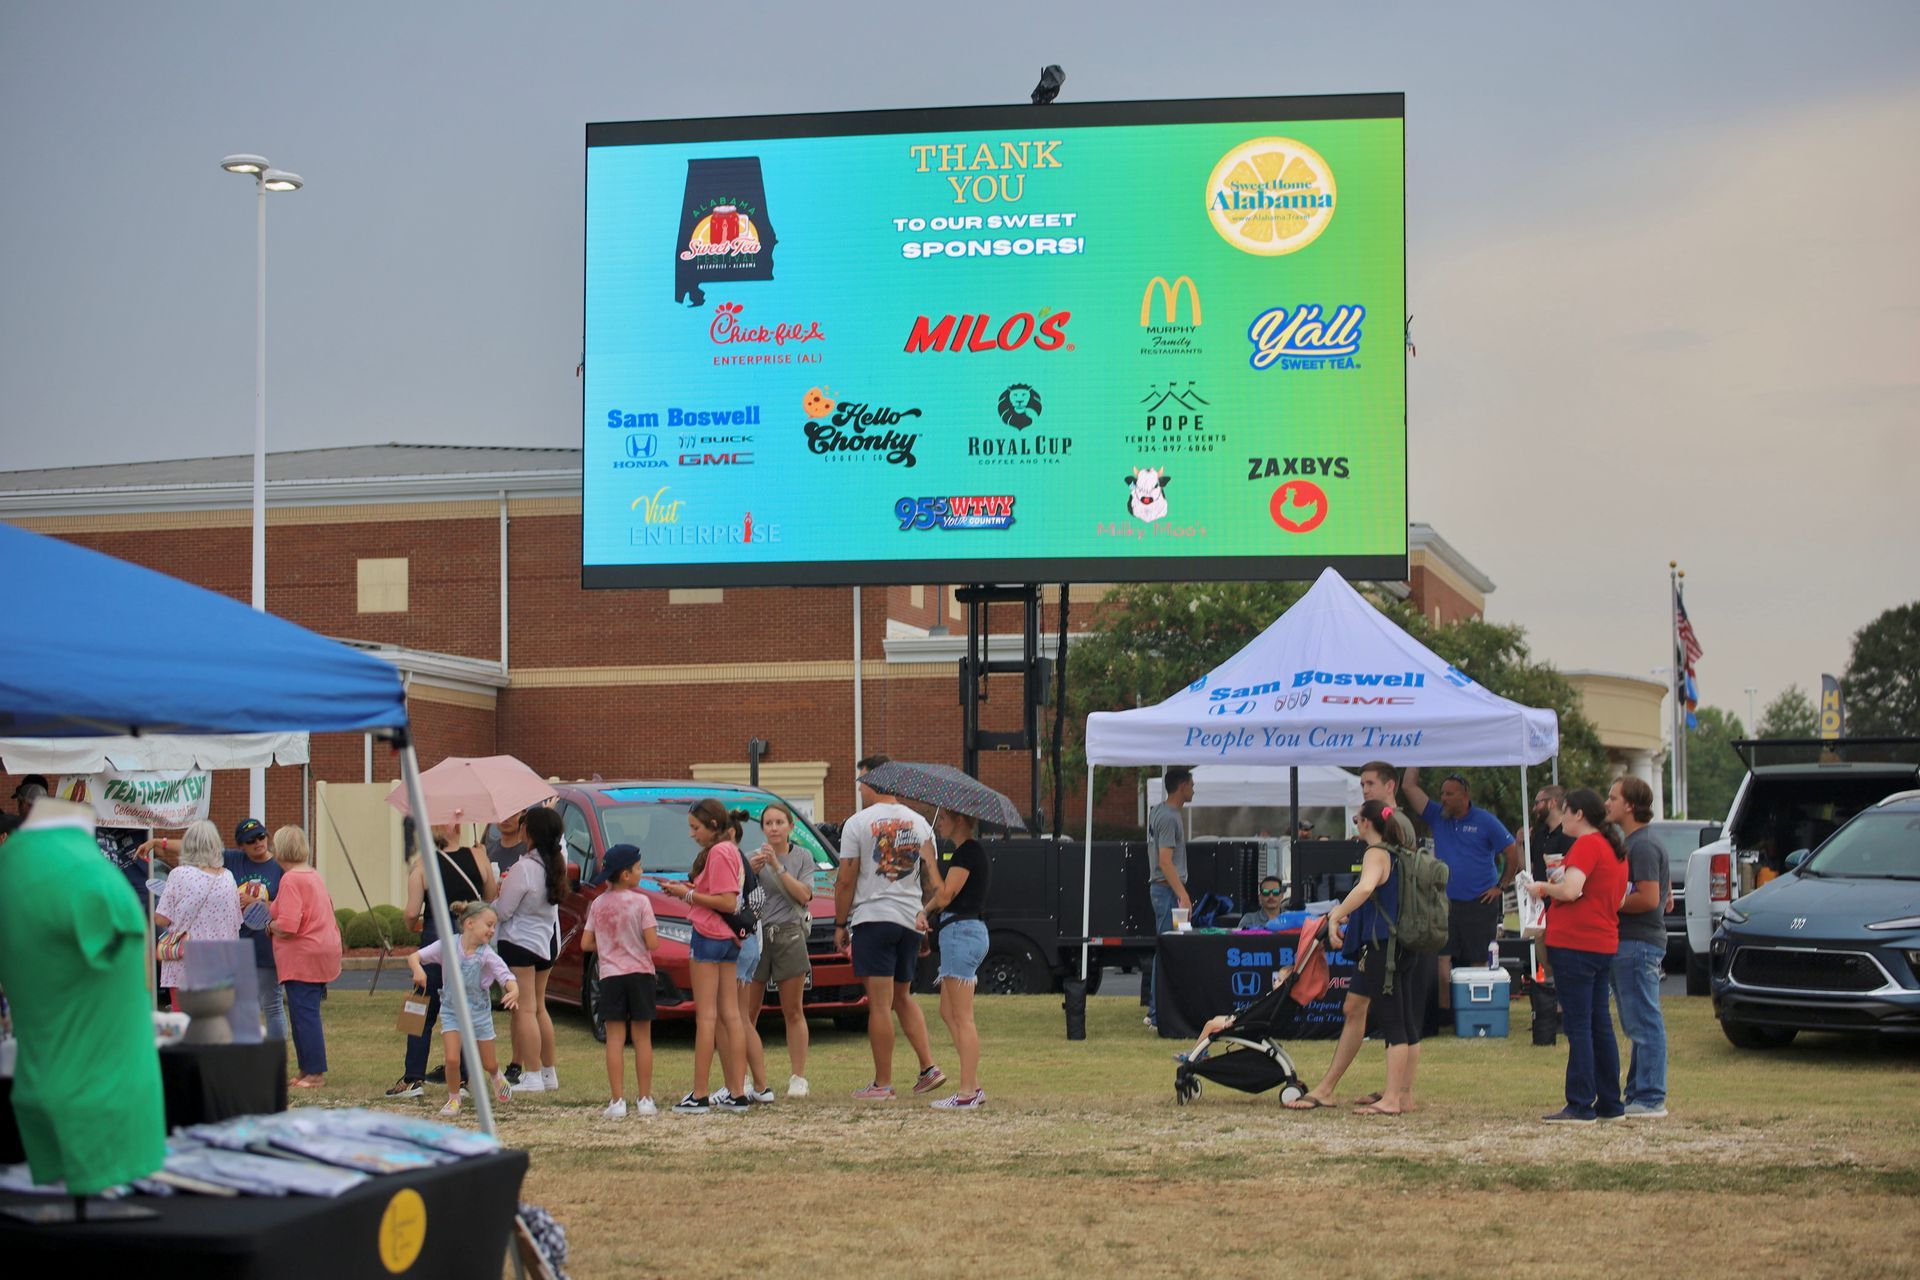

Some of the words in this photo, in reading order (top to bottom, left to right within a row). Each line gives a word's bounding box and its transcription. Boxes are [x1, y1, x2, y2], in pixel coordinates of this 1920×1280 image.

[910, 140, 1063, 173] THANK
[946, 173, 1026, 204] YOU
[1230, 180, 1271, 191] Sweet
[1272, 180, 1313, 190] Home
[692, 196, 756, 218] ALABAMA
[1211, 190, 1333, 211] Alabama
[893, 217, 926, 232] TO
[930, 216, 983, 231] OUR
[987, 213, 1077, 230] SWEET
[680, 239, 731, 260] Sweet
[730, 237, 761, 257] Tea
[902, 236, 1086, 259] SPONSORS!
[1146, 326, 1196, 334] MURPHY
[1152, 336, 1192, 348] Family
[713, 355, 792, 366] ENTERPRISE
[797, 353, 823, 364] (AL)
[1281, 358, 1325, 370] SWEET
[608, 409, 659, 429] Sam
[667, 406, 760, 427] Boswell
[832, 402, 922, 434] Hello
[1146, 415, 1204, 431] POPE
[700, 435, 754, 444] BUICK
[803, 422, 918, 468] Chonky
[613, 460, 669, 469] HONDA
[678, 452, 754, 466] GMC
[1248, 456, 1350, 480] ZAXBYS
[631, 485, 686, 525] Visit
[949, 495, 1014, 517] WTVY
[969, 516, 1007, 526] COUNTRY
[1209, 680, 1281, 701] Sam
[1292, 670, 1426, 689] Boswell
[1321, 695, 1416, 705] GMC
[1184, 726, 1255, 755] People
[1261, 727, 1301, 748] You
[1308, 726, 1354, 748] Can
[1361, 726, 1424, 748] Trust
[181, 776, 207, 802] TENT
[1226, 948, 1273, 967] Sam
[1307, 1001, 1342, 1012] Depend
[1306, 1013, 1324, 1023] Can
